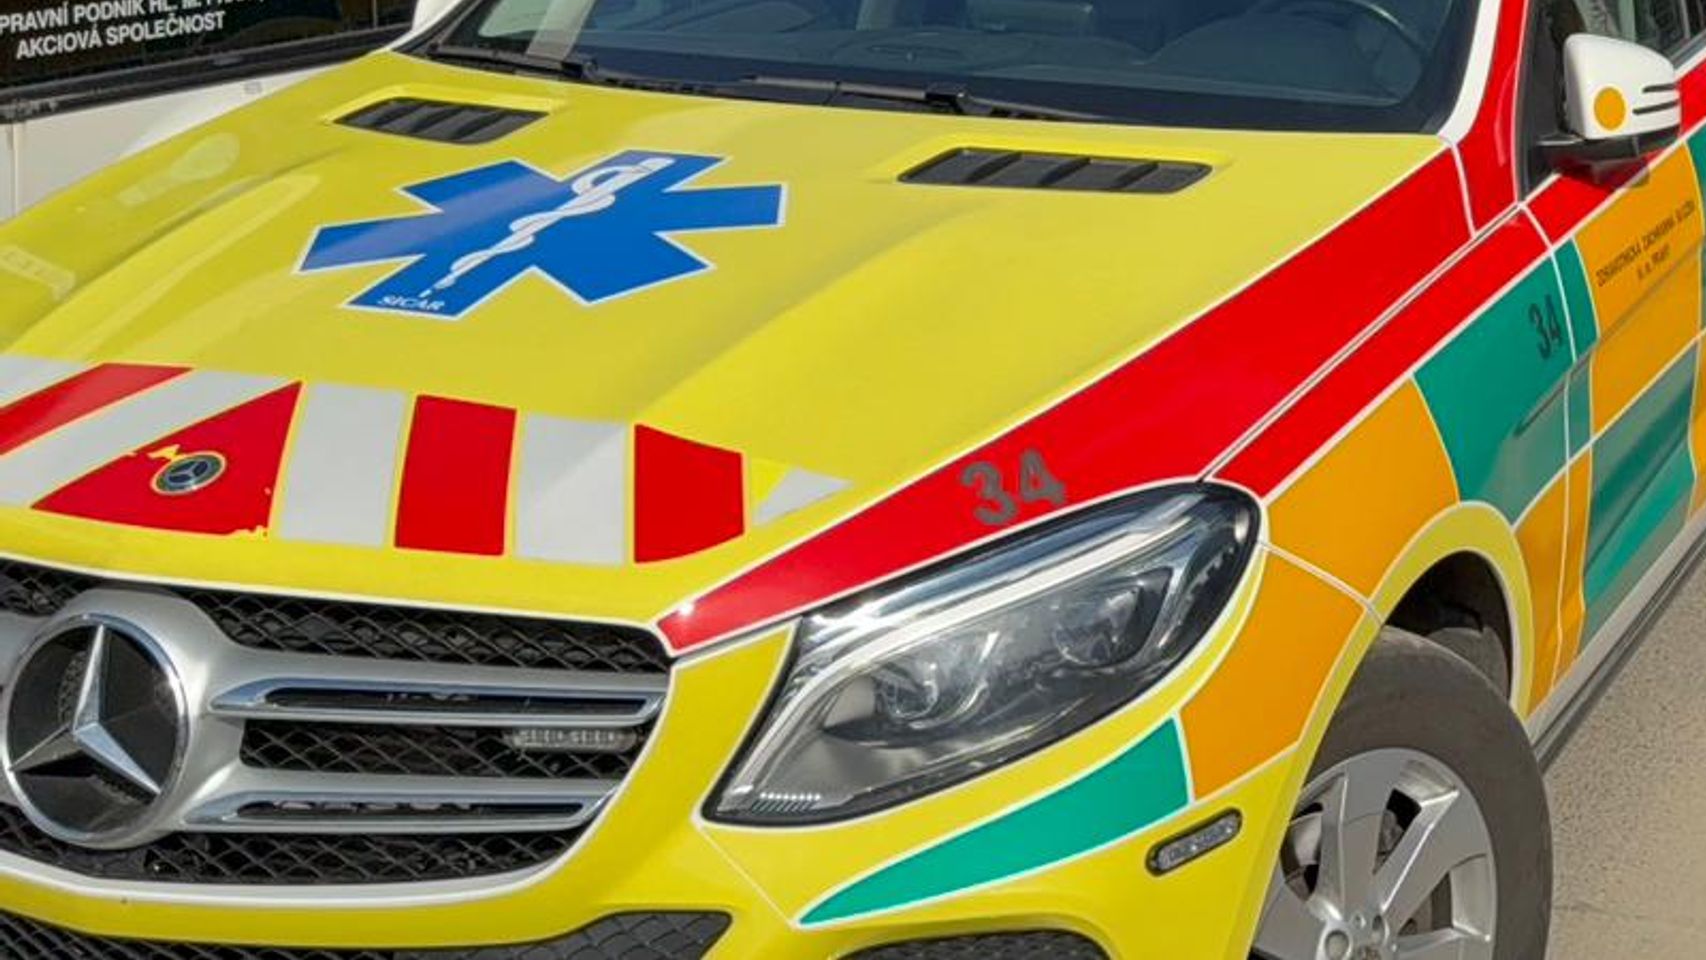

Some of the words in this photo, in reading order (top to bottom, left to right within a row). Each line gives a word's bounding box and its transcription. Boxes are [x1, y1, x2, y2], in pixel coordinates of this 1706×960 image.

[16, 23, 103, 60] AKCIOVÁ
[106, 10, 226, 47] SPOLEČNOST
[1528, 292, 1563, 359] 34
[962, 448, 1065, 525] 34
